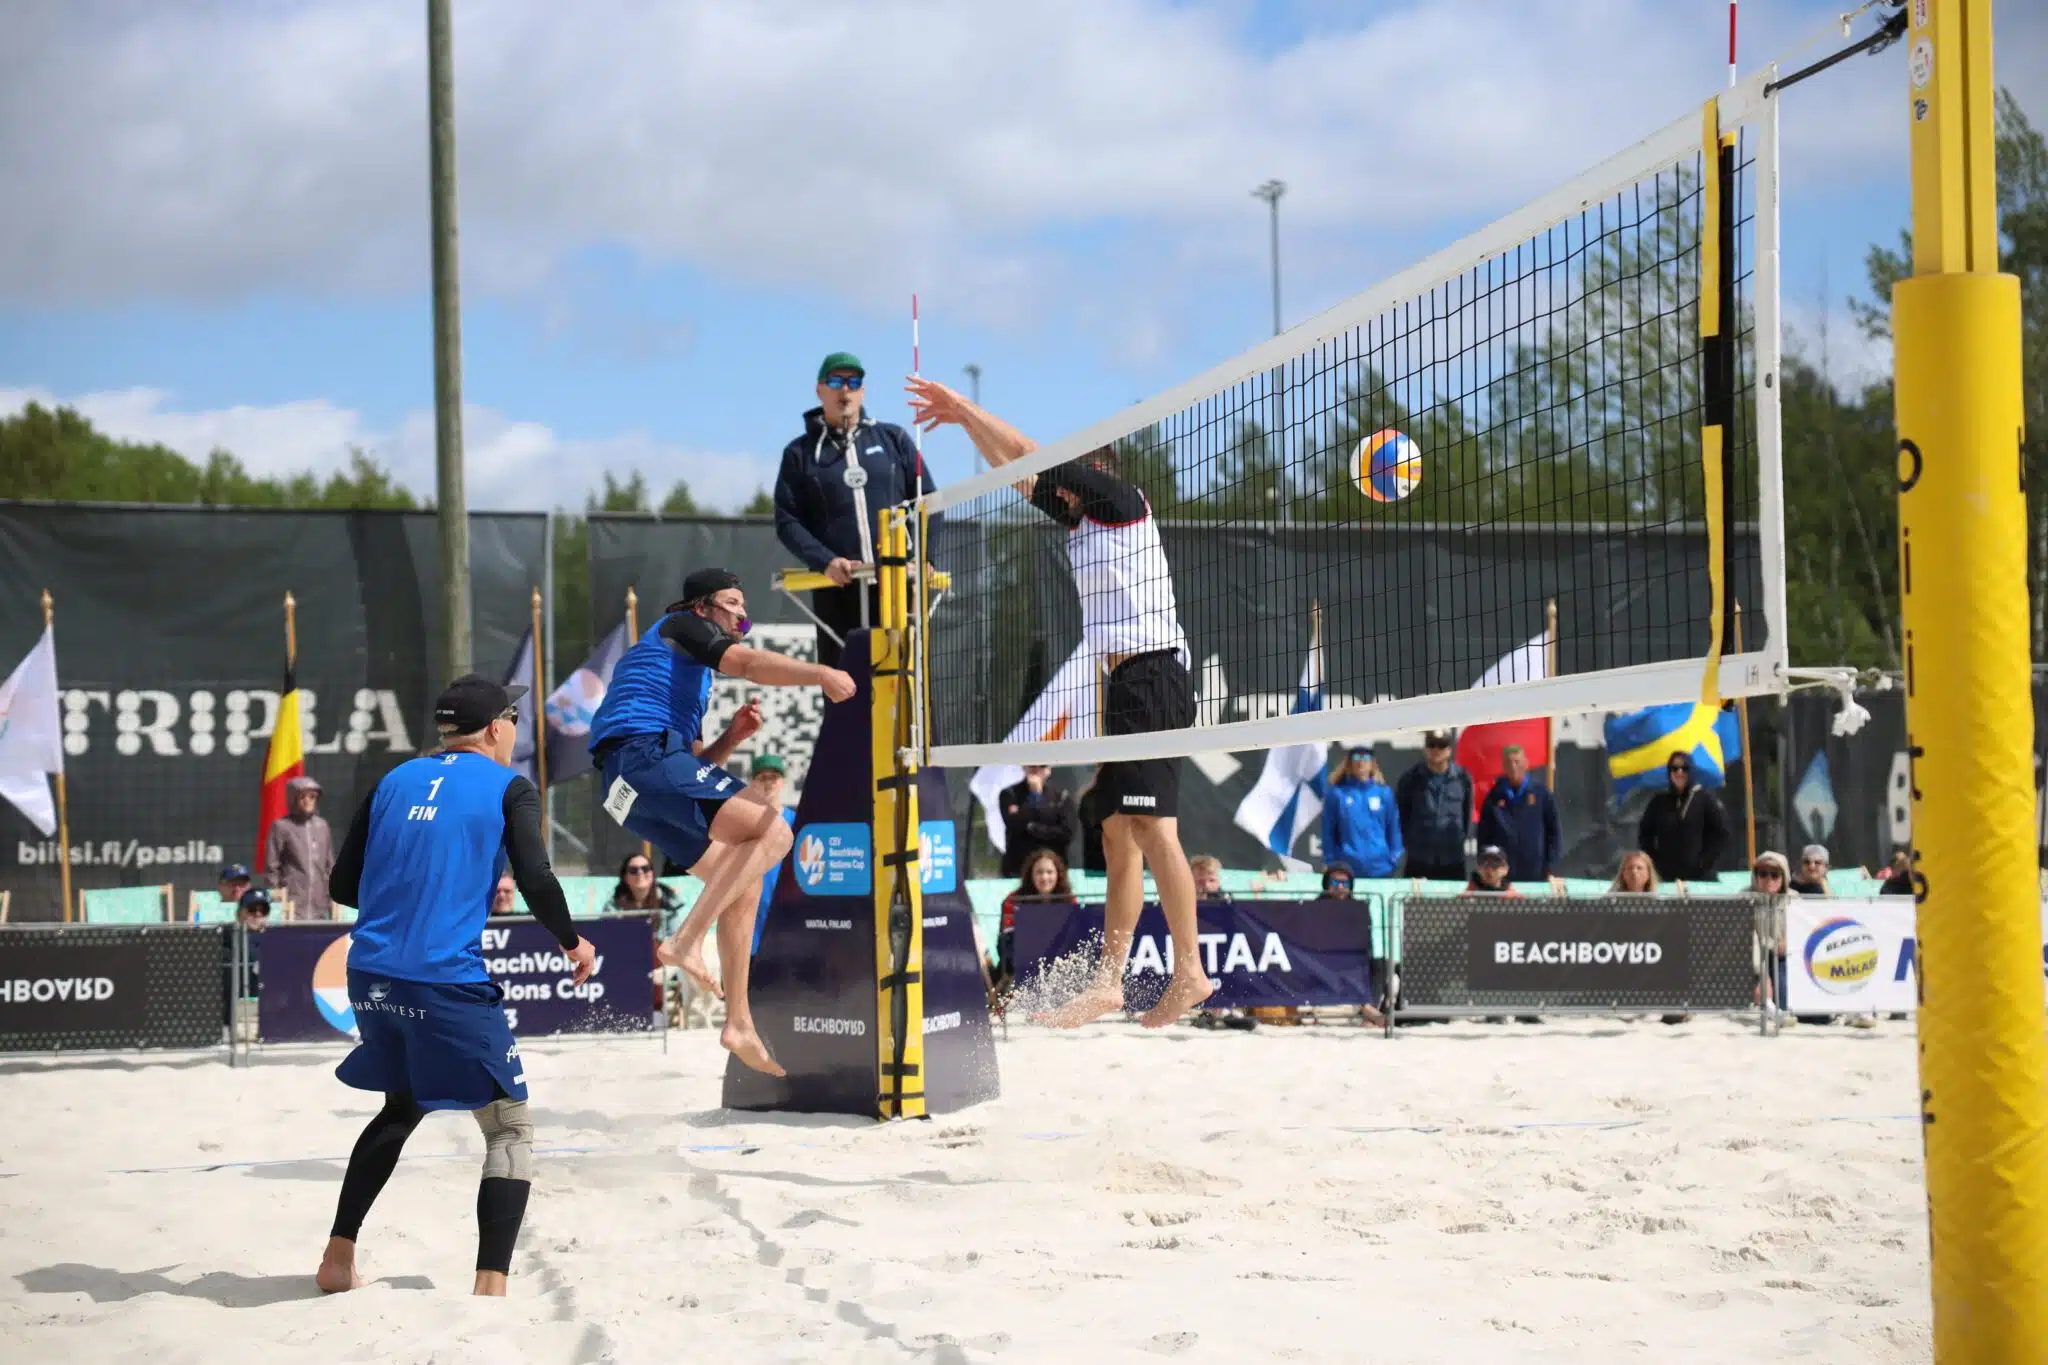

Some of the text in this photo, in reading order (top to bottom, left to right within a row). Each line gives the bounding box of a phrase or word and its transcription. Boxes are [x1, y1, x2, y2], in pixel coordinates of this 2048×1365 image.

[58, 688, 417, 756] TRIPLA
[427, 776, 444, 801] 1
[1122, 795, 1156, 807] KANTOR
[407, 805, 438, 821] FIN
[556, 977, 605, 1003] Cup
